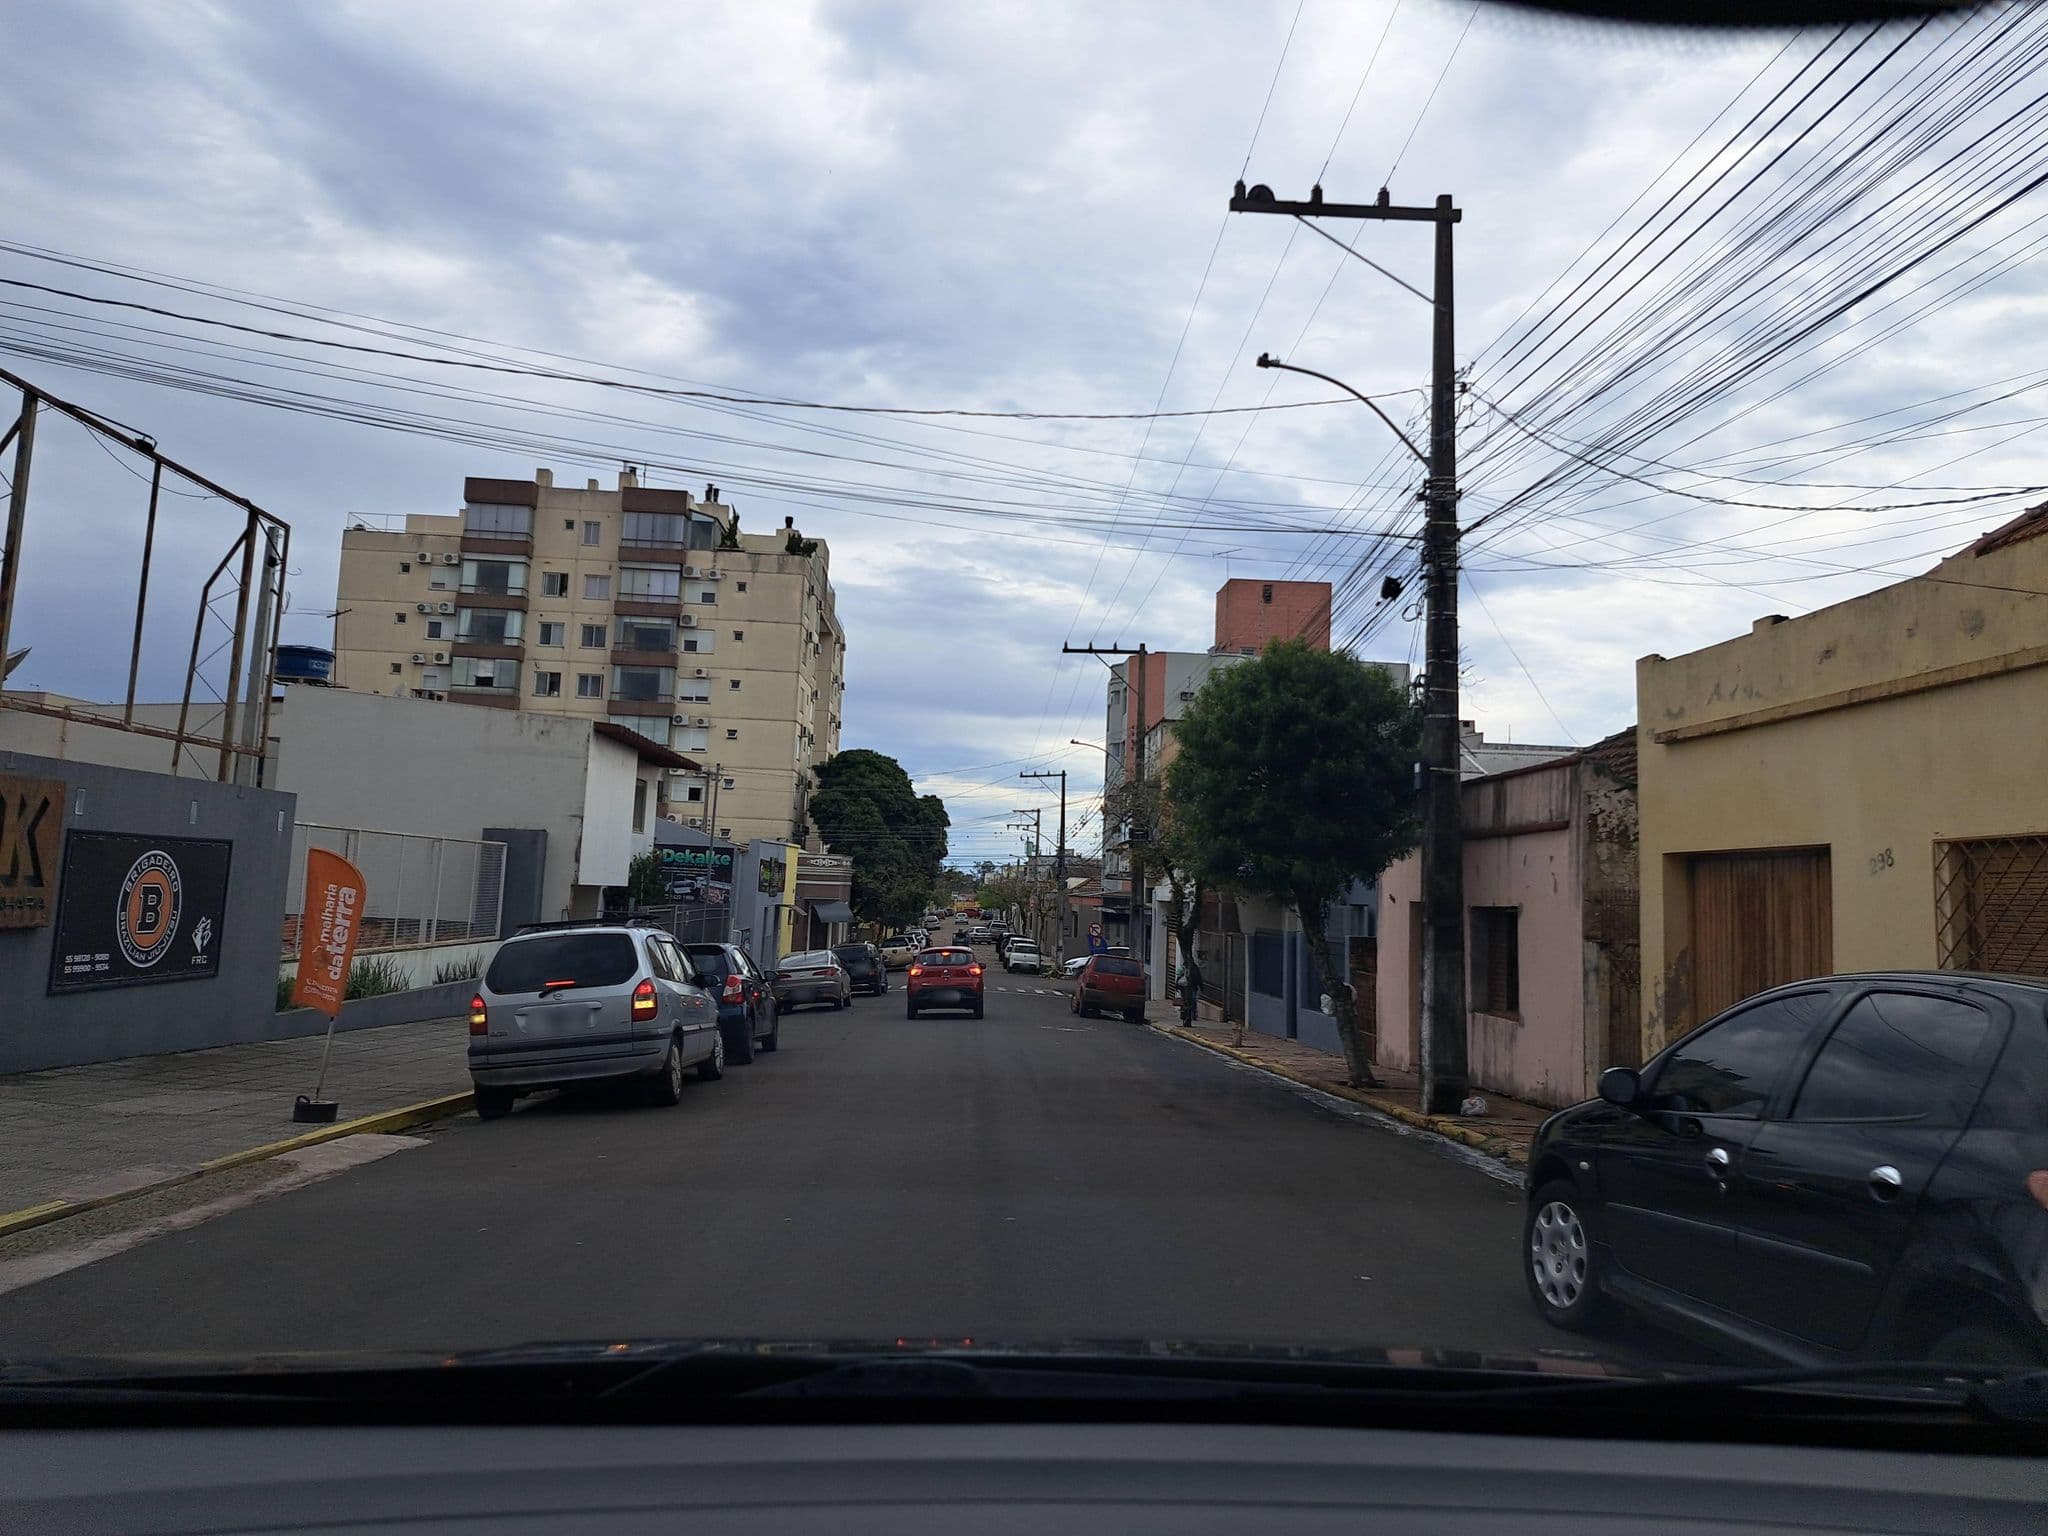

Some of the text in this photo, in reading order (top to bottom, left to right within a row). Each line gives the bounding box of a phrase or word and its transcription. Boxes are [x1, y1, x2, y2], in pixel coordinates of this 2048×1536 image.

[0, 793, 50, 888] K
[662, 848, 731, 866] Dekalke
[125, 856, 178, 893] BRIGADEIRO
[136, 884, 164, 934] B
[320, 884, 338, 942] malharia
[120, 911, 146, 961] BRAZILIAN
